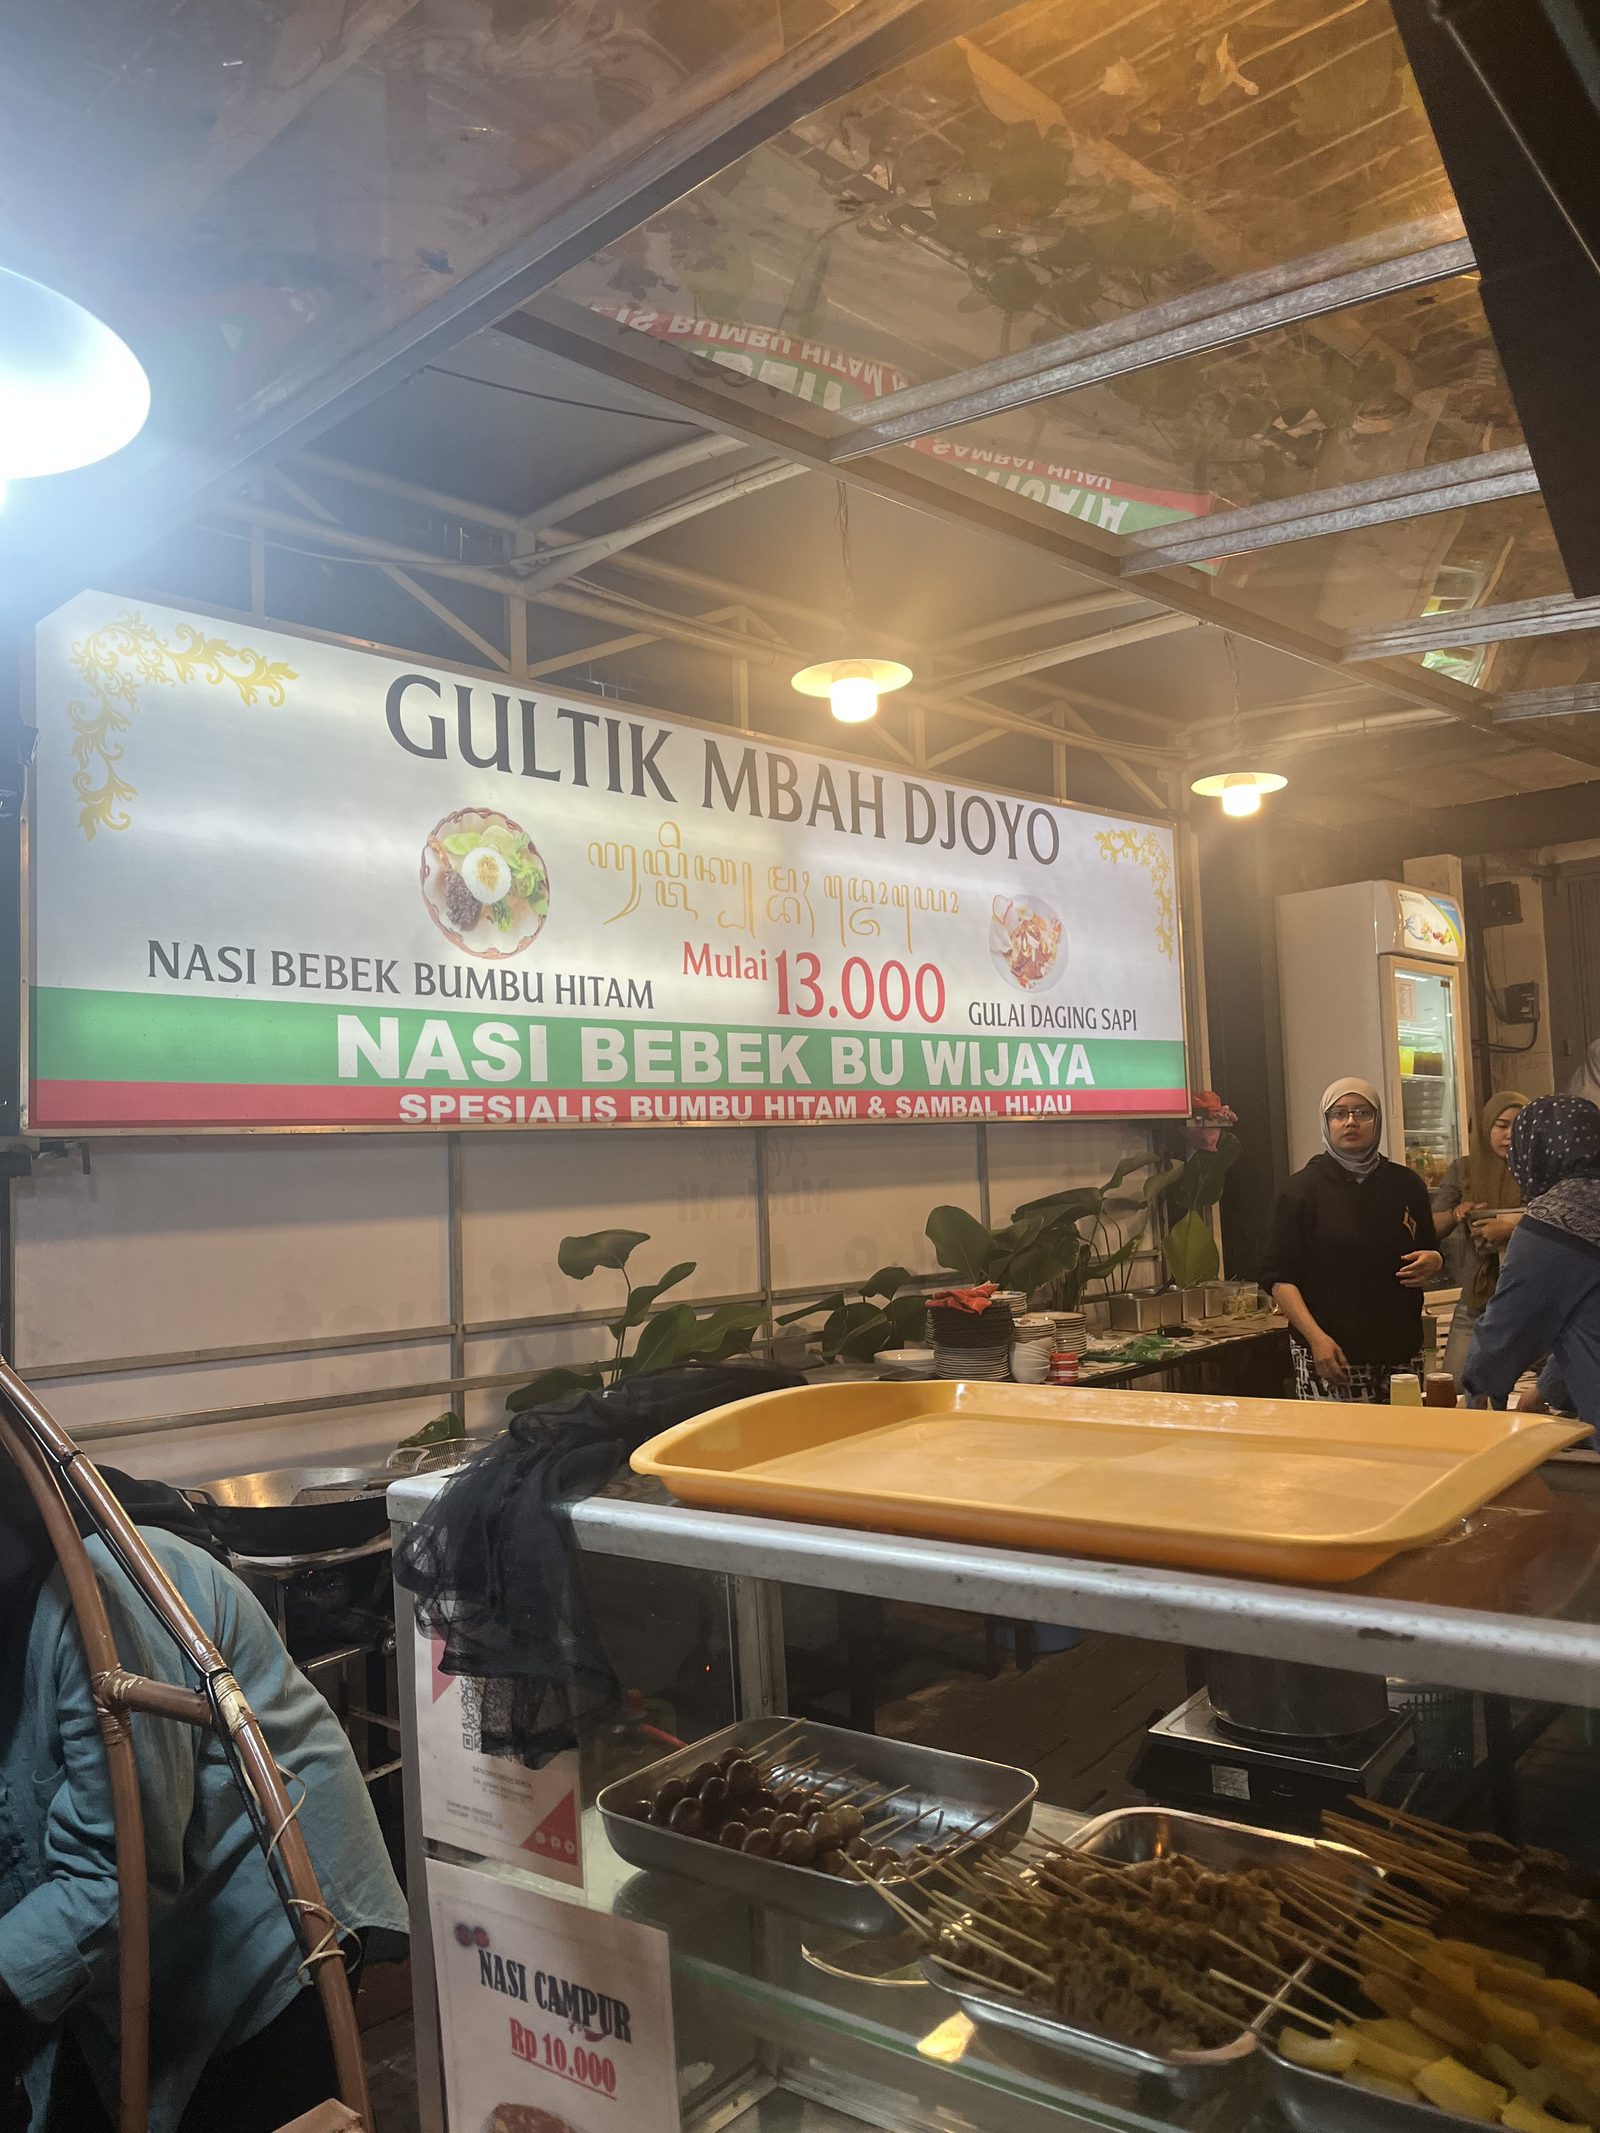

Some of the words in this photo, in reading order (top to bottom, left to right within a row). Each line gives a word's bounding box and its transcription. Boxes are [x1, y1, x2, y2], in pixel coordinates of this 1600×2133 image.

[385, 674, 679, 803] GULTIK
[701, 738, 887, 840] MBAH
[903, 781, 1060, 866] DJOYO
[147, 939, 256, 985] NASI
[271, 951, 400, 995] BEBEK
[413, 963, 544, 1004] BUMBU
[555, 974, 655, 1010] HITAM
[683, 941, 767, 982] Mulai
[774, 950, 946, 1024] 13.000
[337, 1014, 547, 1083] NASI
[580, 1027, 813, 1085] BEBEK
[831, 1037, 904, 1087] BU
[921, 1040, 1096, 1087] WIJAYA
[968, 1002, 1026, 1028] GULAI
[1031, 1005, 1097, 1031] DAGING
[1101, 1009, 1138, 1032] SAPI
[399, 1093, 617, 1124] SPESIALIS
[630, 1095, 752, 1122] BUMBU
[765, 1096, 857, 1120] HITAM
[867, 1096, 887, 1120] &
[1005, 1095, 1072, 1116] HIJAU
[478, 1949, 529, 2003] NASI
[534, 1971, 632, 2044] CAMPUR
[542, 2033, 617, 2093] 10.000
